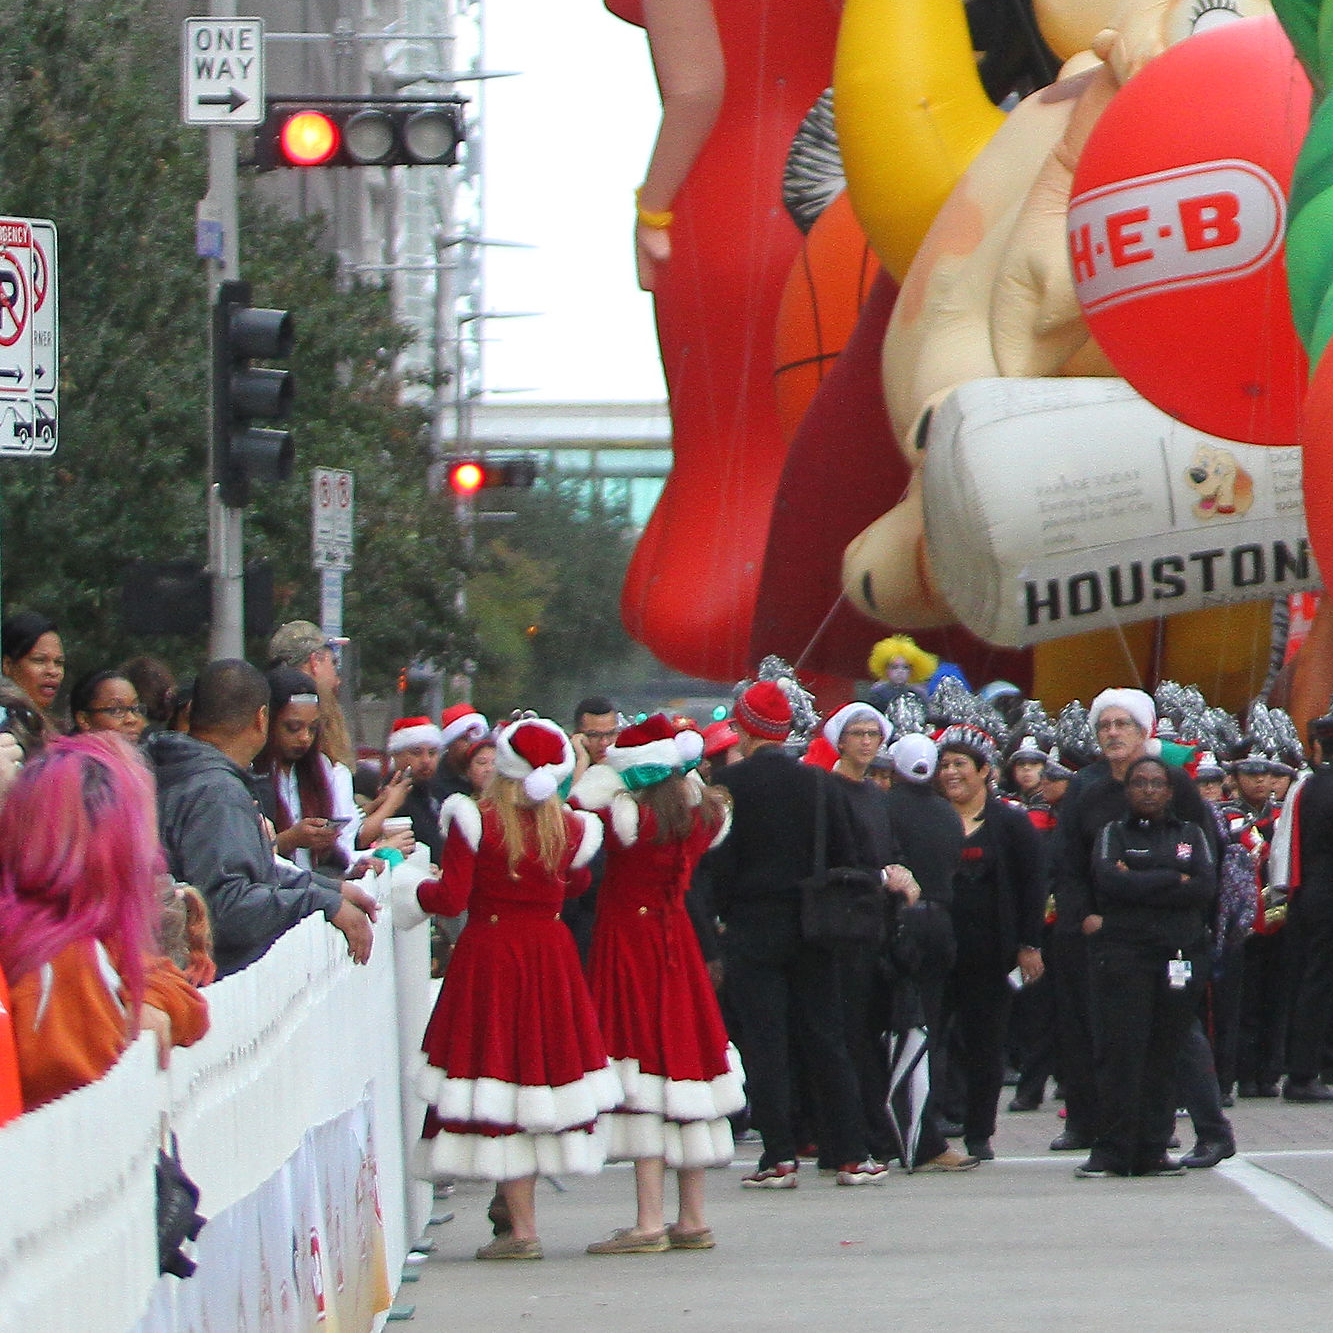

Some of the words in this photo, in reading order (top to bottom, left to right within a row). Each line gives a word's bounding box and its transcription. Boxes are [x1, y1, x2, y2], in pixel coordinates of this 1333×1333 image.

[196, 28, 254, 50] ONE
[196, 56, 255, 79] WAY
[1025, 537, 1310, 625] HOUSTON
